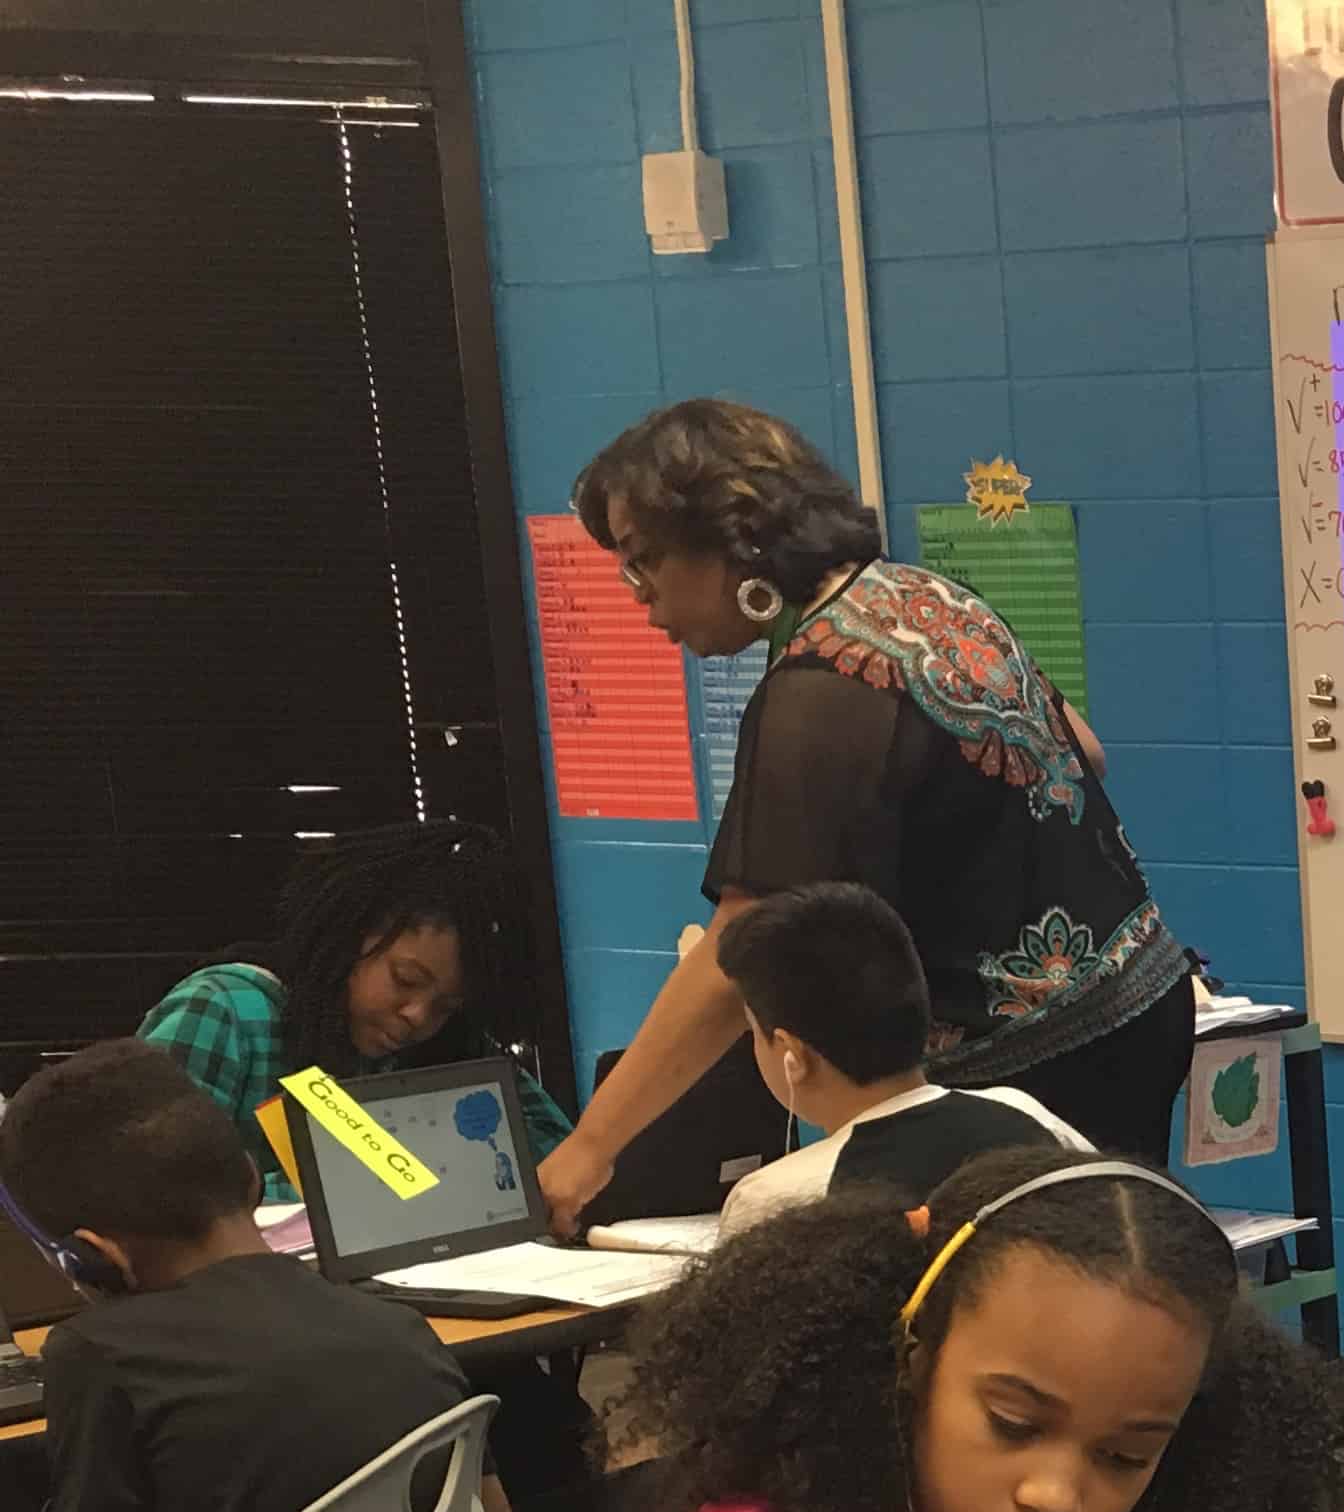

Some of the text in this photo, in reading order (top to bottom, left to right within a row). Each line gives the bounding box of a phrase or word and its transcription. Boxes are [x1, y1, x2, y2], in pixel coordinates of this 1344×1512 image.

[307, 1079, 416, 1184] Good to Go
